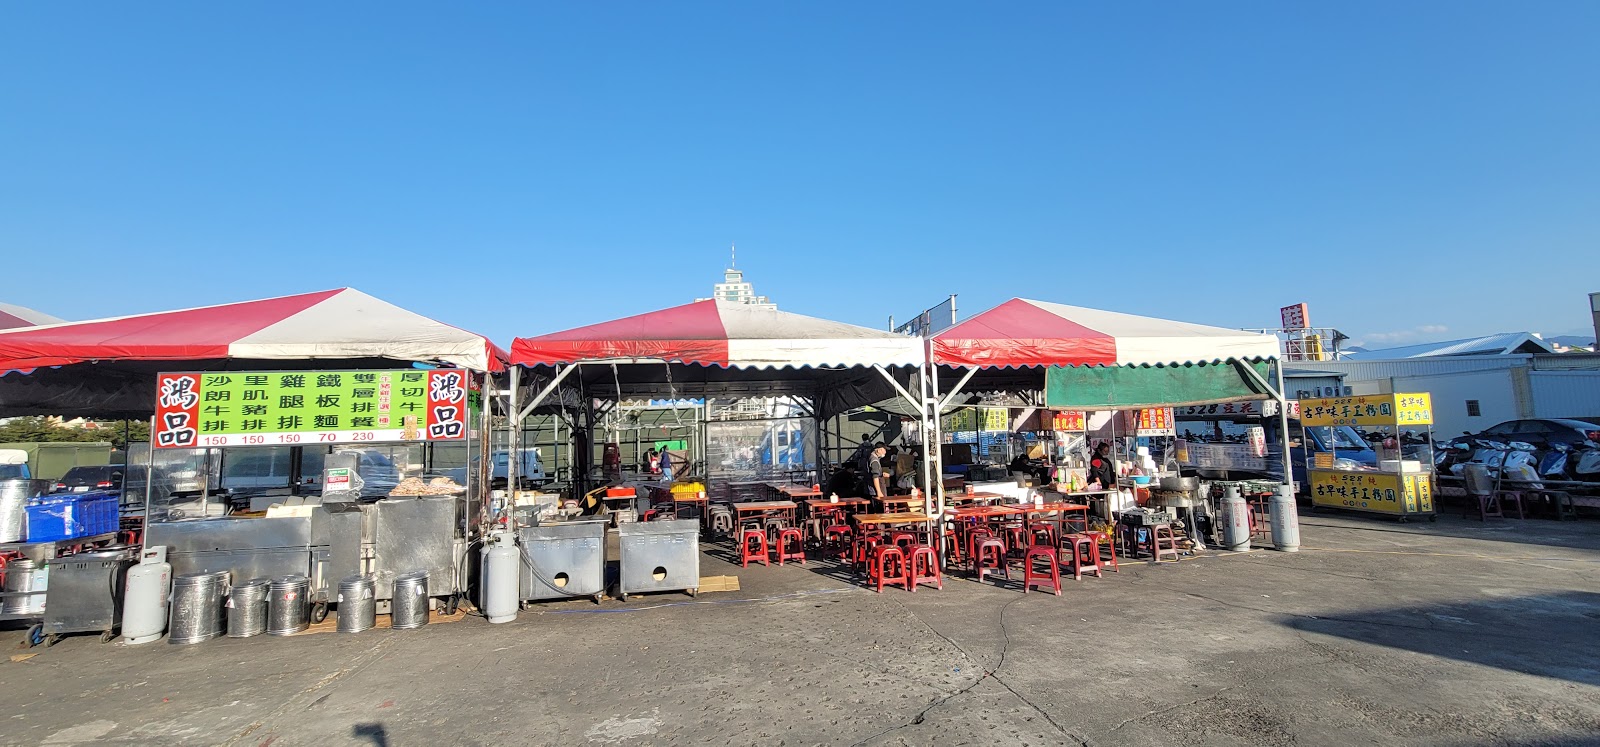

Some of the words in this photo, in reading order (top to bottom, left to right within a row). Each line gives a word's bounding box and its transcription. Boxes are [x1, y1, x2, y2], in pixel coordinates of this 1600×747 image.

[202, 375, 232, 432] 沙朗牛排
[241, 375, 270, 431] 里肌豬排
[277, 374, 306, 430] 雞腿排
[313, 374, 342, 428] 鐵板麵
[350, 373, 377, 428] 雙層排餐
[430, 372, 465, 438] 鴻品
[1400, 397, 1425, 408] 古早味
[158, 376, 199, 446] 鴻品
[1187, 403, 1219, 415] 528
[1222, 402, 1259, 414] 豆花
[1274, 402, 1292, 414] 58
[1303, 402, 1392, 419] 古早味手工粉圓
[1398, 410, 1430, 421] 手工粉圓
[205, 436, 227, 446] 150
[242, 435, 264, 444] 150
[279, 434, 300, 443] 150
[319, 433, 336, 442] 70
[352, 432, 374, 441] 230
[399, 431, 421, 440] 20
[1341, 474, 1363, 482] 528
[1316, 483, 1396, 503] 古早味手工粉圓
[1421, 484, 1431, 510] 古早味
